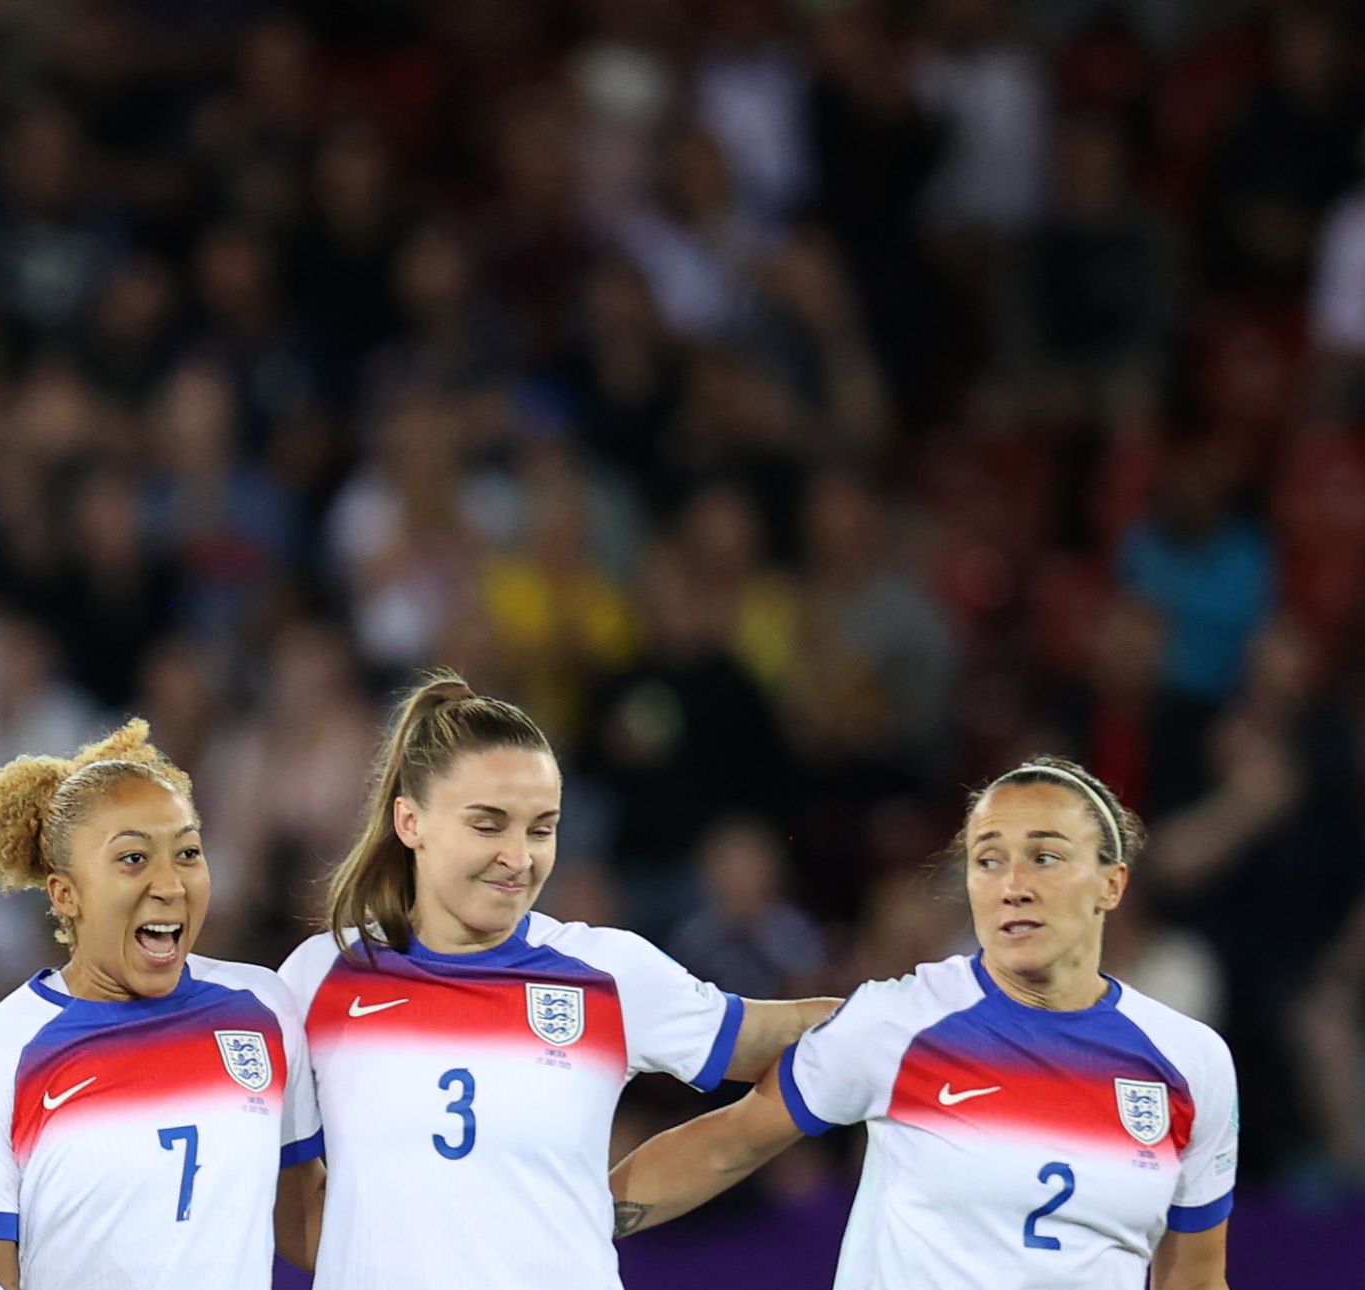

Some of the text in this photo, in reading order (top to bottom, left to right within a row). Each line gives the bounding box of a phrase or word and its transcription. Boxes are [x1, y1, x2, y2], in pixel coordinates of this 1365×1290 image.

[432, 1068, 476, 1160] 3
[157, 1125, 201, 1222] 7
[1024, 1162, 1075, 1250] 2
